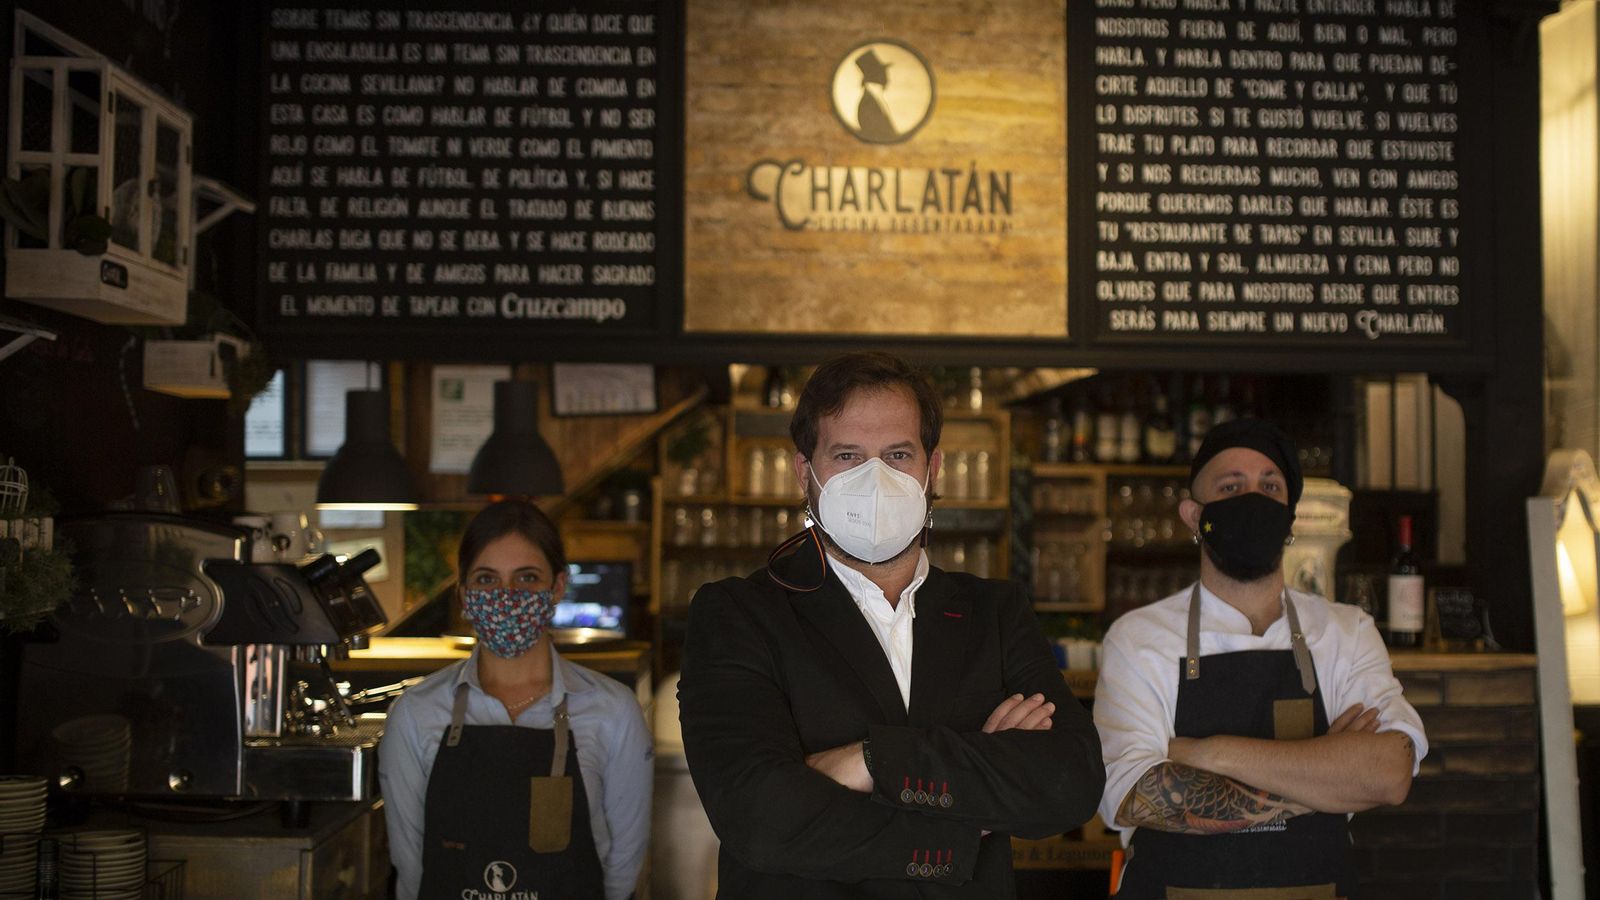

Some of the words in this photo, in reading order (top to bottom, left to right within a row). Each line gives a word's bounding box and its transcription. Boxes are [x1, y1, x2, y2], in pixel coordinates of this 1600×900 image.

[1095, 20, 1170, 37] NOSOTROS
[1179, 22, 1227, 39] FUERA
[1237, 23, 1256, 40] DE
[1314, 25, 1347, 42] BIEN
[1357, 26, 1369, 42] O
[1422, 27, 1458, 44] PERO
[1157, 49, 1167, 68] Y
[1174, 50, 1223, 69] HABLA
[1229, 51, 1283, 70] DENTRO
[1290, 52, 1326, 71] PARA
[1333, 53, 1360, 72] QUE
[1369, 54, 1423, 73] PUEDAN
[270, 76, 291, 94] LA
[300, 76, 352, 95] COCINA
[453, 77, 475, 96] NO
[483, 78, 539, 96] HABLAR
[548, 78, 565, 97] DE
[575, 78, 628, 97] COMIDA
[636, 79, 656, 97] EN
[1096, 77, 1138, 96] CIRTE
[1145, 79, 1208, 98] AQUELLO
[1215, 80, 1233, 98] DE
[1295, 81, 1305, 100] Y
[1385, 83, 1395, 102] Y
[1402, 84, 1430, 102] QUE
[1096, 105, 1117, 125] LO
[1209, 108, 1225, 127] SI
[1233, 108, 1251, 128] TE
[1257, 106, 1304, 128] GUSTÓ
[1376, 111, 1390, 131] SI
[1397, 112, 1458, 131] VUELVES
[270, 137, 307, 155] ROJO
[314, 137, 355, 156] COMO
[361, 137, 377, 156] EL
[389, 138, 438, 156] TOMATE
[446, 138, 462, 157] NI
[469, 138, 512, 157] VERDE
[519, 139, 561, 158] COMO
[566, 139, 583, 158] EL
[591, 139, 653, 158] PIMIENTO
[1098, 135, 1135, 155] TRAE
[1144, 136, 1164, 155] TU
[1171, 137, 1215, 156] PLATO
[1222, 138, 1259, 157] PARA
[1266, 139, 1338, 158] RECORDAR
[1346, 140, 1373, 159] QUE
[1381, 141, 1453, 160] ESTUVISTE
[270, 164, 303, 188] AQUÍ
[311, 168, 327, 188] SE
[337, 168, 384, 188] HABLA
[391, 168, 408, 188] DE
[482, 169, 500, 189] DE
[508, 167, 568, 189] POLÍTICA
[597, 170, 613, 189] SI
[618, 170, 654, 189] HACE
[1098, 163, 1109, 184] Y
[1118, 164, 1134, 184] SI
[1142, 164, 1172, 185] NOS
[1180, 166, 1261, 185] RECUERDAS
[1333, 168, 1360, 187] VEN
[1369, 169, 1398, 188] CON
[1407, 170, 1458, 189] AMIGOS
[746, 157, 1014, 231] CHARLATÁN
[1096, 193, 1151, 213] PORQUE
[1159, 195, 1233, 214] QUEREMOS
[1239, 196, 1293, 215] DARLES
[1299, 197, 1327, 216] QUE
[1399, 195, 1433, 218] ÉSTE
[1440, 199, 1459, 219] ES
[319, 199, 337, 218] DE
[347, 196, 409, 218] RELIGIÓN
[417, 199, 470, 218] AUNQUE
[480, 199, 496, 218] EL
[509, 200, 567, 218] TRATADO
[574, 200, 592, 219] DE
[601, 200, 655, 219] BUENAS
[269, 231, 333, 249] CHARLAS
[339, 231, 372, 250] DIGA
[378, 231, 405, 250] QUE
[412, 231, 434, 250] NO
[439, 232, 456, 250] SE
[510, 232, 520, 251] Y
[526, 232, 543, 251] SE
[550, 232, 586, 251] HACE
[592, 233, 655, 251] RODEADO
[1098, 223, 1119, 242] TU
[1234, 225, 1252, 244] DE
[1313, 226, 1333, 245] EN
[1406, 227, 1441, 246] SUBE
[1449, 228, 1459, 247] Y
[268, 263, 286, 283] DE
[297, 263, 316, 283] LA
[325, 264, 378, 283] FAMILIA
[387, 264, 397, 283] Y
[406, 264, 423, 284] DE
[434, 264, 486, 284] AMIGOS
[494, 264, 530, 284] PARA
[538, 264, 583, 284] HACER
[592, 265, 654, 285] SAGRADO
[1145, 253, 1192, 273] ENTRA
[1200, 254, 1210, 273] Y
[1256, 255, 1330, 274] ALMUERZA
[1337, 255, 1347, 274] Y
[1354, 256, 1391, 275] CENA
[1397, 256, 1433, 275] PERO
[1439, 257, 1460, 276] NO
[1096, 282, 1156, 301] OLVIDES
[1162, 282, 1191, 302] QUE
[1199, 283, 1235, 302] PARA
[1242, 283, 1314, 303] NOSOTROS
[1321, 284, 1364, 304] DESDE
[1372, 285, 1399, 304] QUE
[1407, 285, 1459, 305] ENTRES
[280, 295, 297, 316] EL
[306, 295, 375, 317] MOMENTO
[381, 295, 399, 317] DE
[409, 295, 459, 317] TAPEAR
[466, 295, 496, 317] CON
[501, 292, 627, 323] Cruzcampo
[1110, 306, 1156, 331] SERÁS
[1163, 312, 1200, 332] PARA
[1207, 312, 1265, 332] SIEMPRE
[1274, 312, 1294, 332] UN
[1301, 313, 1348, 332] NUEVO
